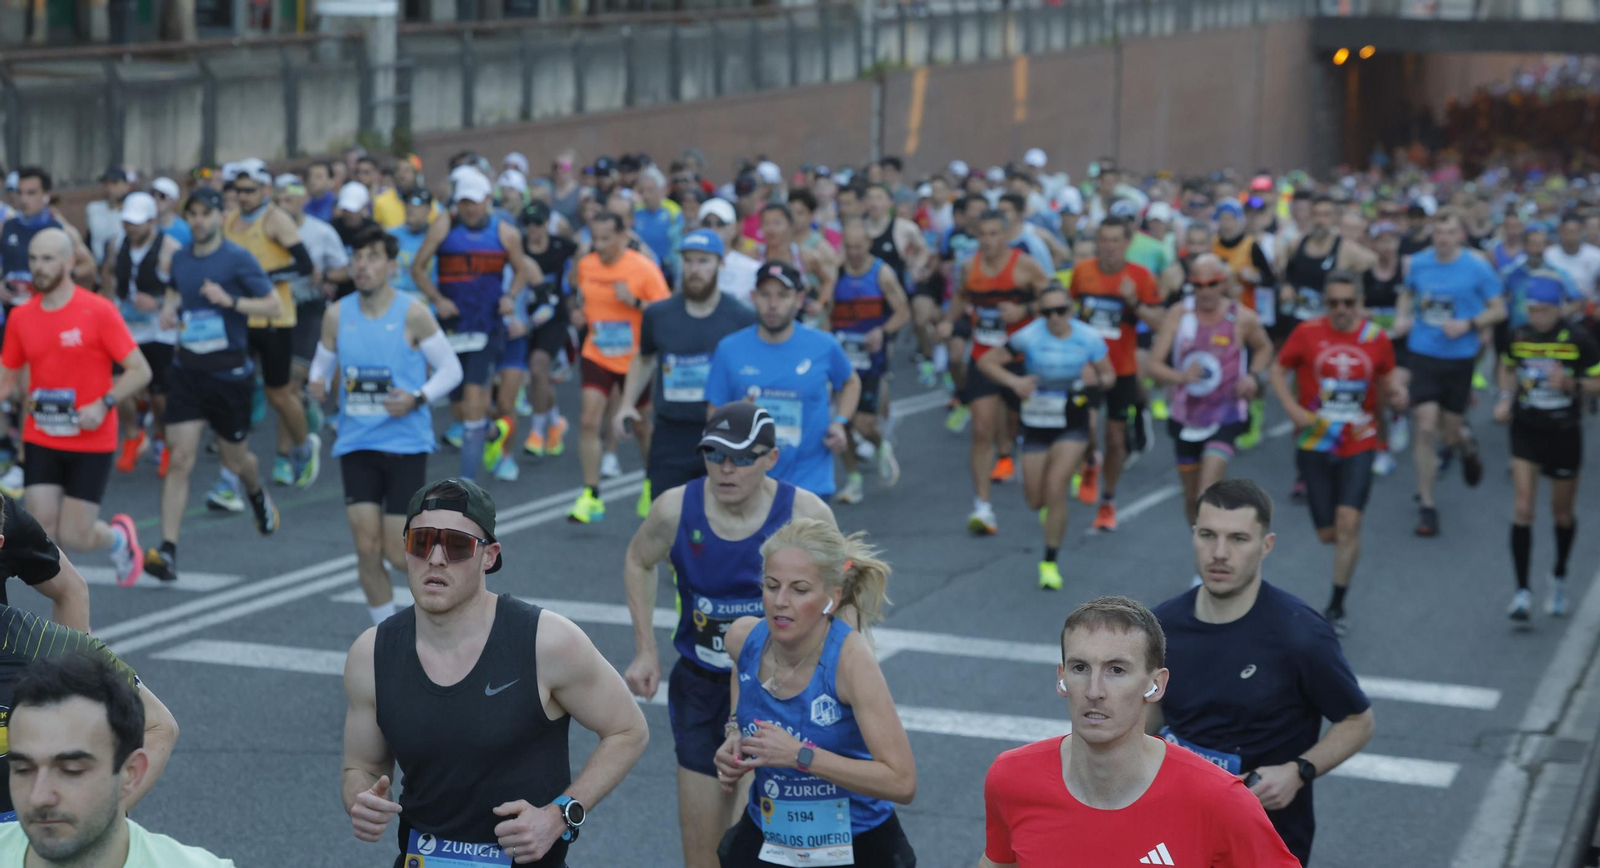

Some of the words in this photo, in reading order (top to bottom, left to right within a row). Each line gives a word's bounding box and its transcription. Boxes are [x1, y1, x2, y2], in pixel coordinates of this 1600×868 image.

[717, 602, 764, 614] ZURICH
[784, 784, 837, 797] ZURICH
[787, 811, 814, 822] 5194
[789, 835, 804, 847] OS
[807, 832, 850, 847] QUIERO
[442, 840, 500, 859] ZURICH
